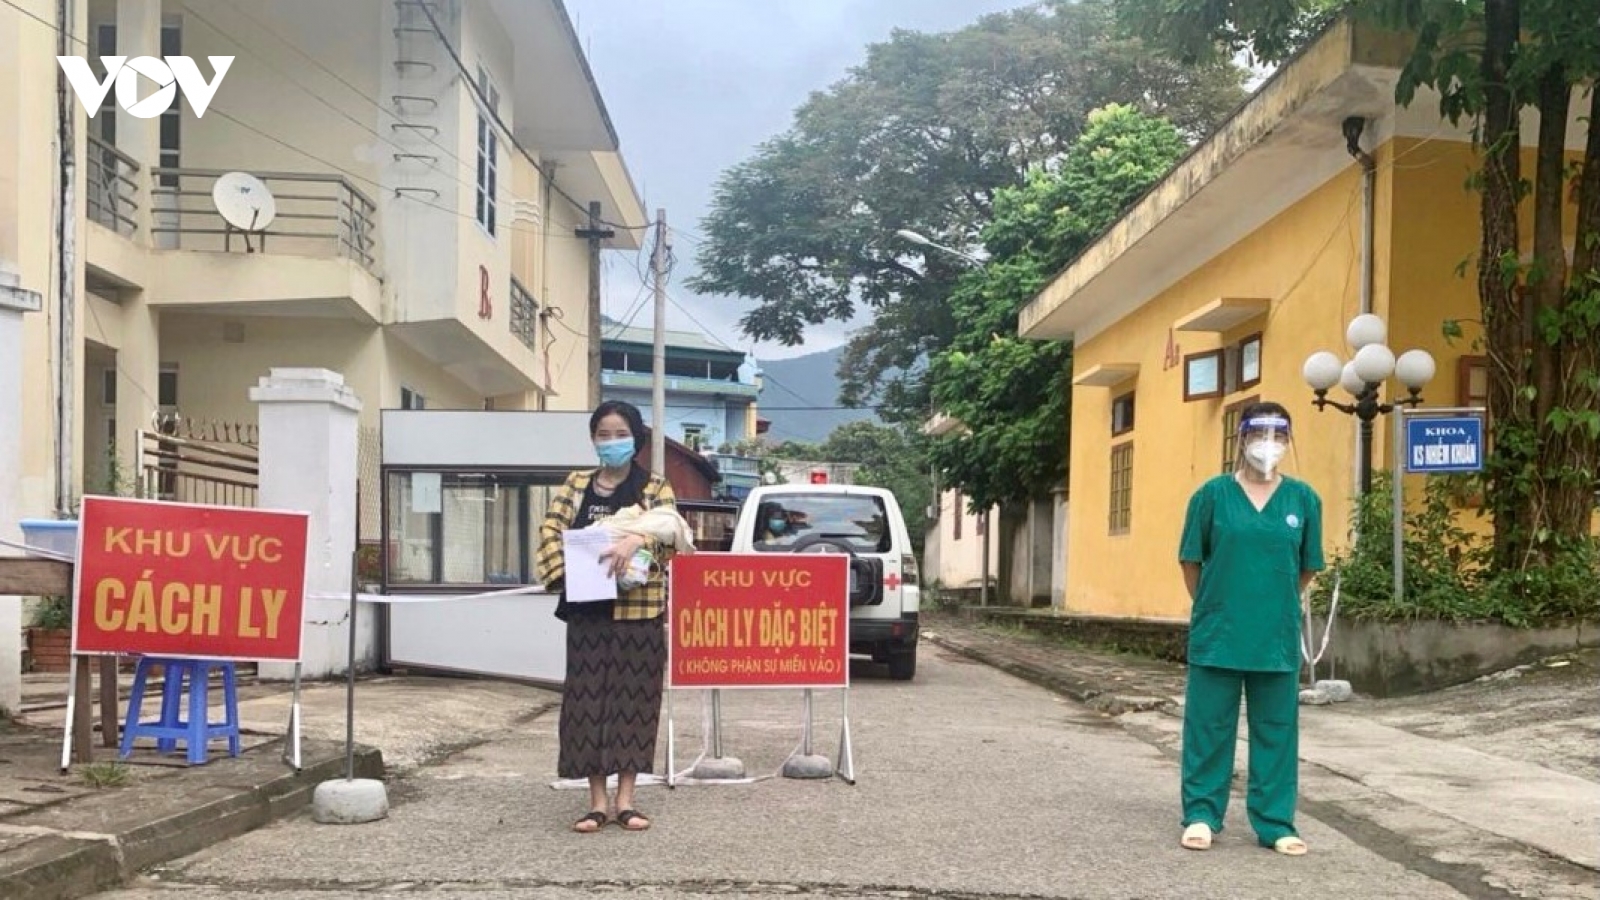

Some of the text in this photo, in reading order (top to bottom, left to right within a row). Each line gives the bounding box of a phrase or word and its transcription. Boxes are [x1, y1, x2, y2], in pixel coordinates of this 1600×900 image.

[1425, 427, 1466, 436] KHOA
[104, 526, 283, 570] KHU VỰC
[703, 568, 812, 592] KHU VỰC
[94, 569, 288, 639] CÁCH LY
[680, 600, 838, 654] CÁCH LY ĐẶC BIỆT
